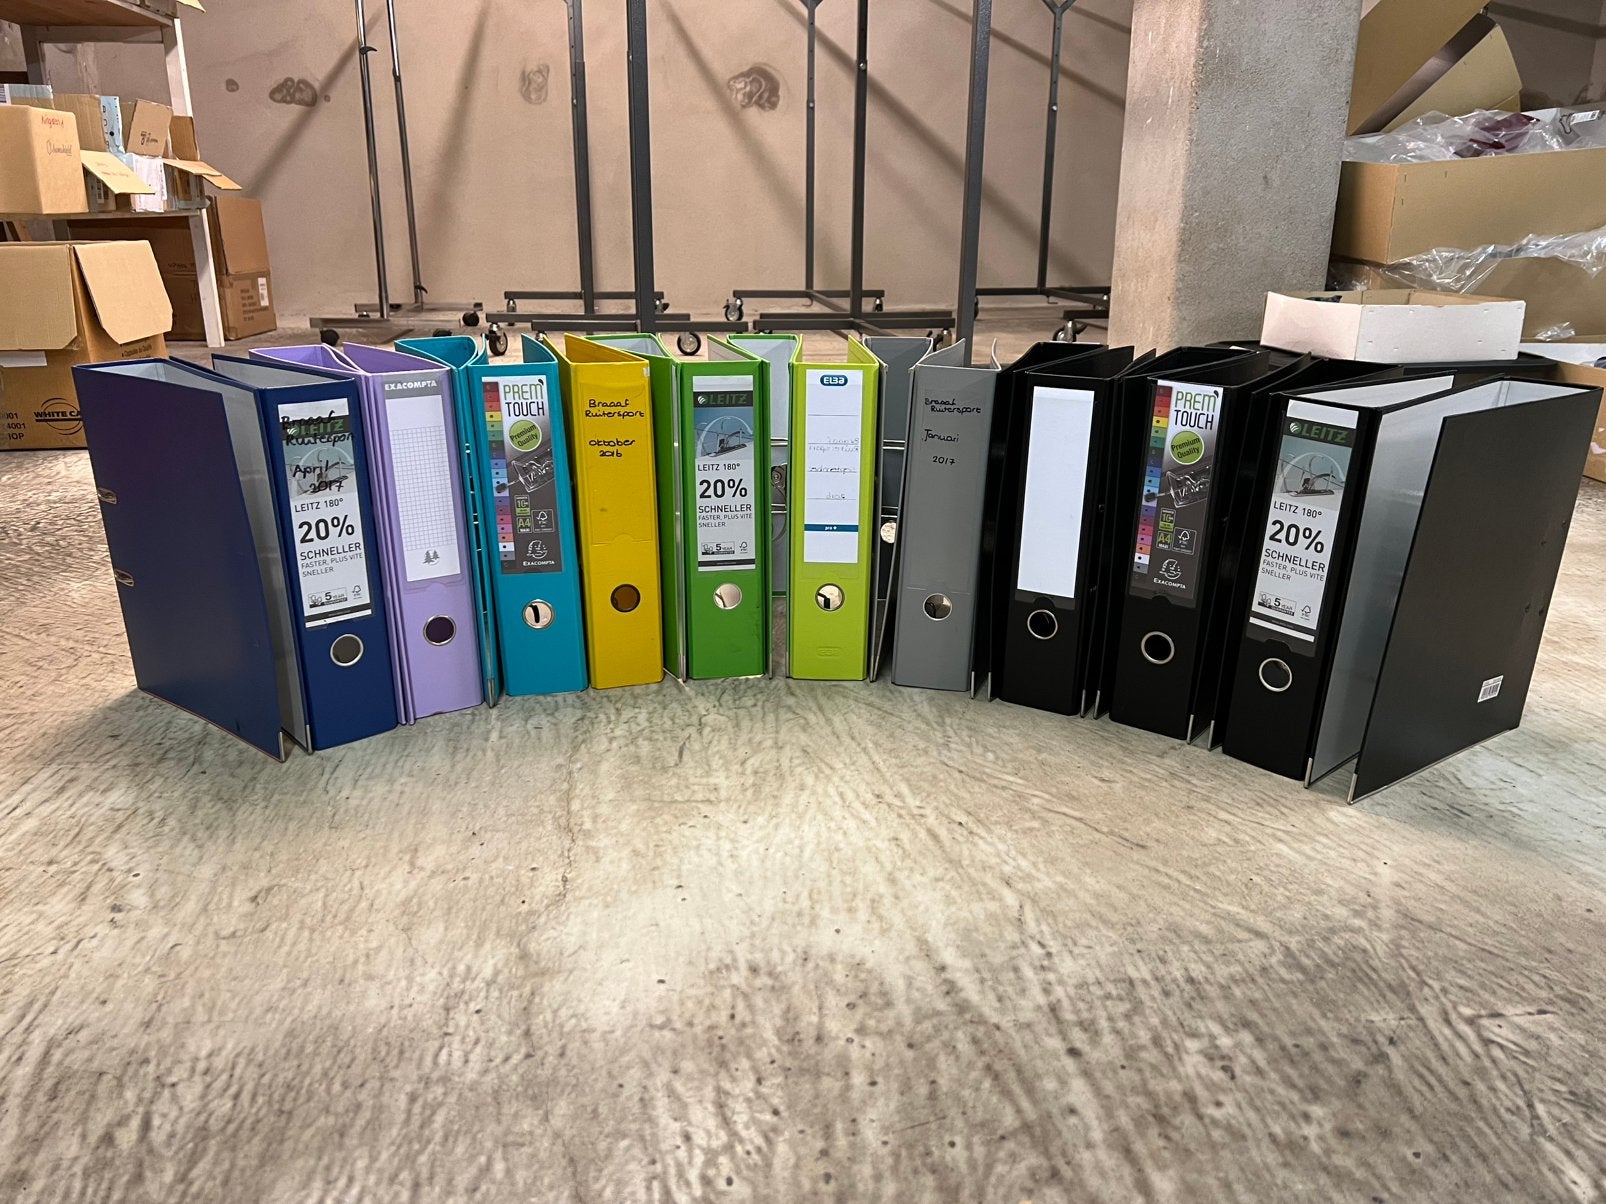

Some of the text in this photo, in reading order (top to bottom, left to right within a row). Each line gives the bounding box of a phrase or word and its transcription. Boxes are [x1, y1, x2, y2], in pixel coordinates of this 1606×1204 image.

[384, 380, 438, 391] EXACOMPTA
[709, 393, 748, 405] LEITZ
[33, 410, 68, 418] WHITE
[505, 401, 545, 417] TOUCH
[585, 409, 645, 419] Ruitersport
[1174, 409, 1215, 431] TOUCH
[510, 424, 538, 442] Premium
[517, 432, 539, 447] Quality
[1301, 423, 1350, 443] LEITZ
[1171, 437, 1201, 452] Premium
[599, 449, 623, 458] 2016
[1177, 446, 1201, 459] Quality
[932, 455, 956, 465] 2017
[292, 460, 329, 479] April
[698, 463, 720, 471] LEITZ
[698, 478, 748, 499] 20%
[294, 501, 321, 513] LEITZ
[698, 503, 752, 514] SCHNELLER
[1273, 500, 1299, 514] LEITZ
[298, 514, 355, 544] 20%
[518, 518, 531, 528] A4
[1158, 532, 1171, 544] A4
[1268, 519, 1325, 554] 20%
[300, 541, 362, 561] SCHNELLER
[715, 543, 722, 551] 5
[301, 552, 363, 570] FASTER, PLUS VITE
[1264, 548, 1326, 573] SCHNELLER
[302, 566, 335, 578] SNELLER
[1261, 567, 1292, 581] SNELLER
[1262, 558, 1325, 582] FASTER, PLUS VITE
[1153, 577, 1186, 590] EXACOMPTA
[324, 591, 332, 601] 5
[1273, 597, 1281, 607] 5
